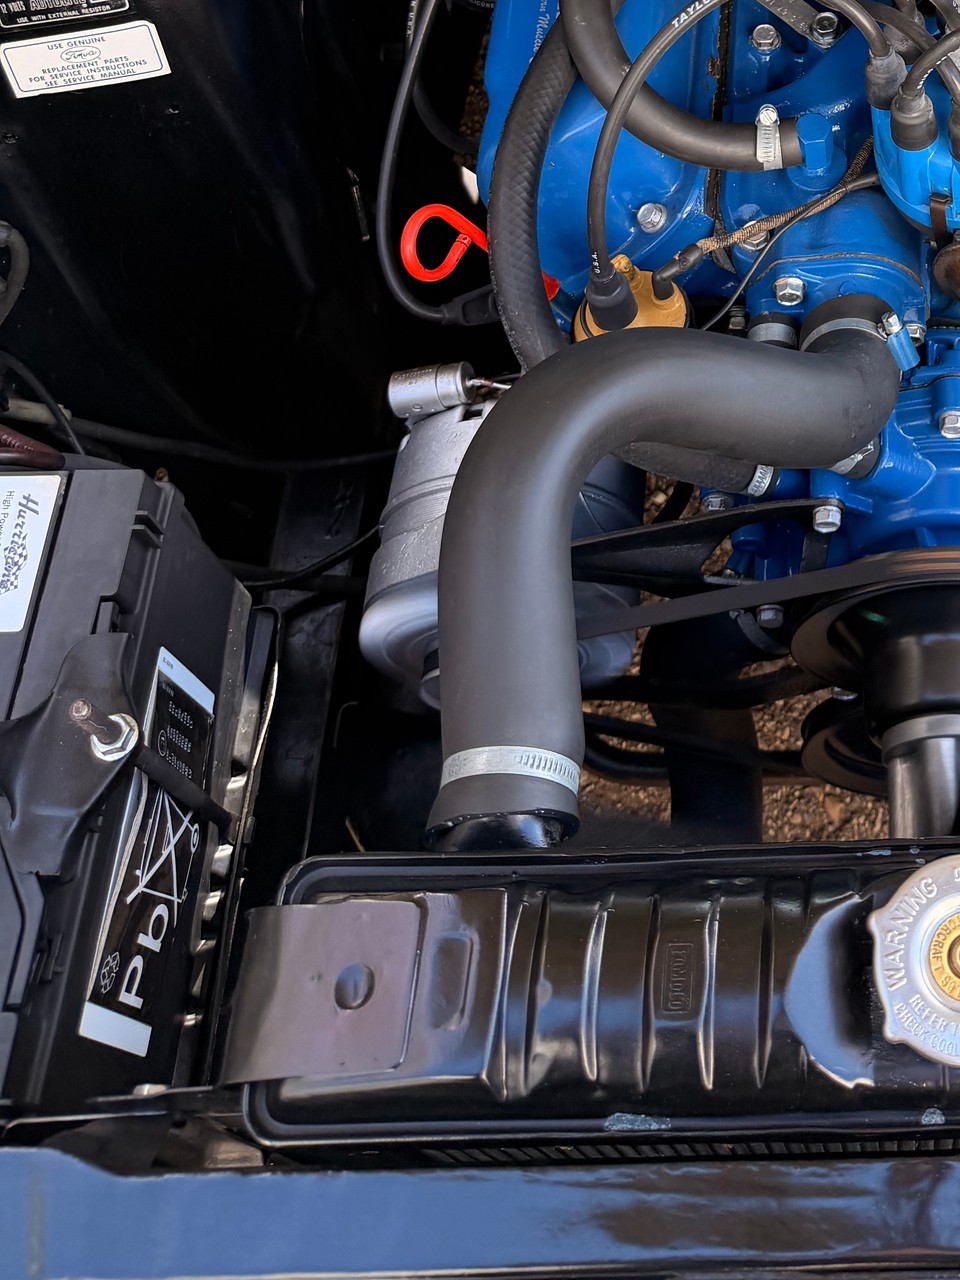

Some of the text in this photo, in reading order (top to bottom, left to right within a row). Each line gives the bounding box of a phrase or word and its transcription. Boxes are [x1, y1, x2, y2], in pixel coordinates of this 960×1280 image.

[9, 1, 26, 13] VOLTS
[17, 16, 29, 24] USE
[48, 10, 80, 19] EXTERNAL
[81, 5, 111, 14] RESISTOR
[47, 36, 106, 51] USE GENUINE
[29, 59, 148, 84] FOR SERVICE INSTRUCTIONS
[42, 55, 129, 75] REPLACEMENT PARTS
[63, 74, 95, 85] SERVICE
[100, 68, 137, 79] MANUAL
[592, 251, 601, 274] U.S.A.
[2, 490, 15, 510] High
[883, 877, 938, 991] WARNING
[117, 903, 171, 1010] Pb
[893, 1002, 928, 1042] CHECK
[908, 994, 949, 1033] REFER
